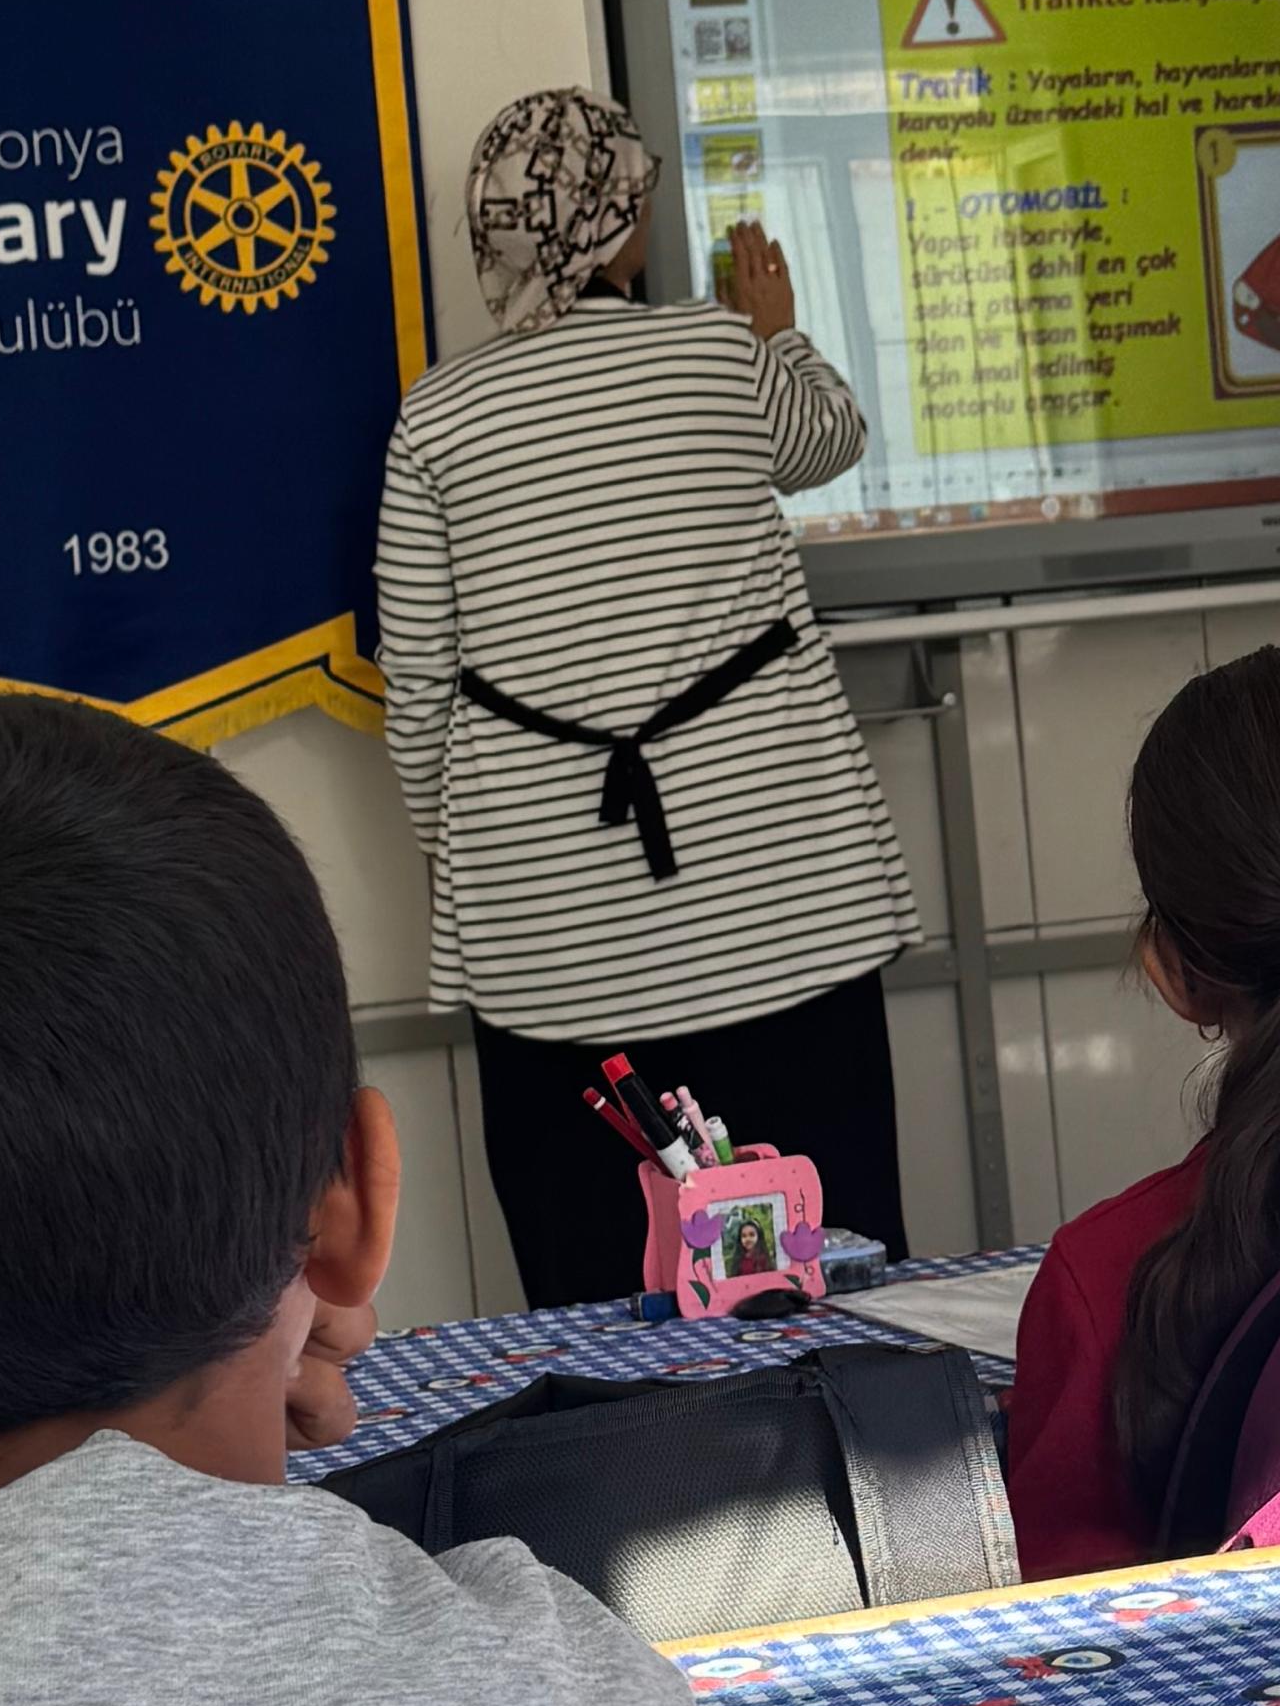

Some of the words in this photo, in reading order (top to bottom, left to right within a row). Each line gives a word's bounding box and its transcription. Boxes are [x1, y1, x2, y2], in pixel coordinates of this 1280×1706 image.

[898, 64, 992, 100] Trafik
[897, 110, 996, 135] karayolu
[1006, 96, 1125, 126] üzerindeki
[1135, 95, 1168, 118] hal
[1178, 96, 1203, 114] ve
[199, 143, 276, 169] ROTARY
[960, 181, 1108, 218] OTOMOBİL
[184, 241, 311, 293] INTERNATIONAL
[1028, 254, 1086, 280] dahil
[1097, 256, 1126, 274] en
[1136, 248, 1177, 278] çok
[1085, 284, 1133, 314] yeri
[1089, 313, 1181, 344] taşımak
[1036, 351, 1116, 380] edilmiş
[921, 395, 1015, 421] motorlu
[62, 529, 170, 575] 1983
